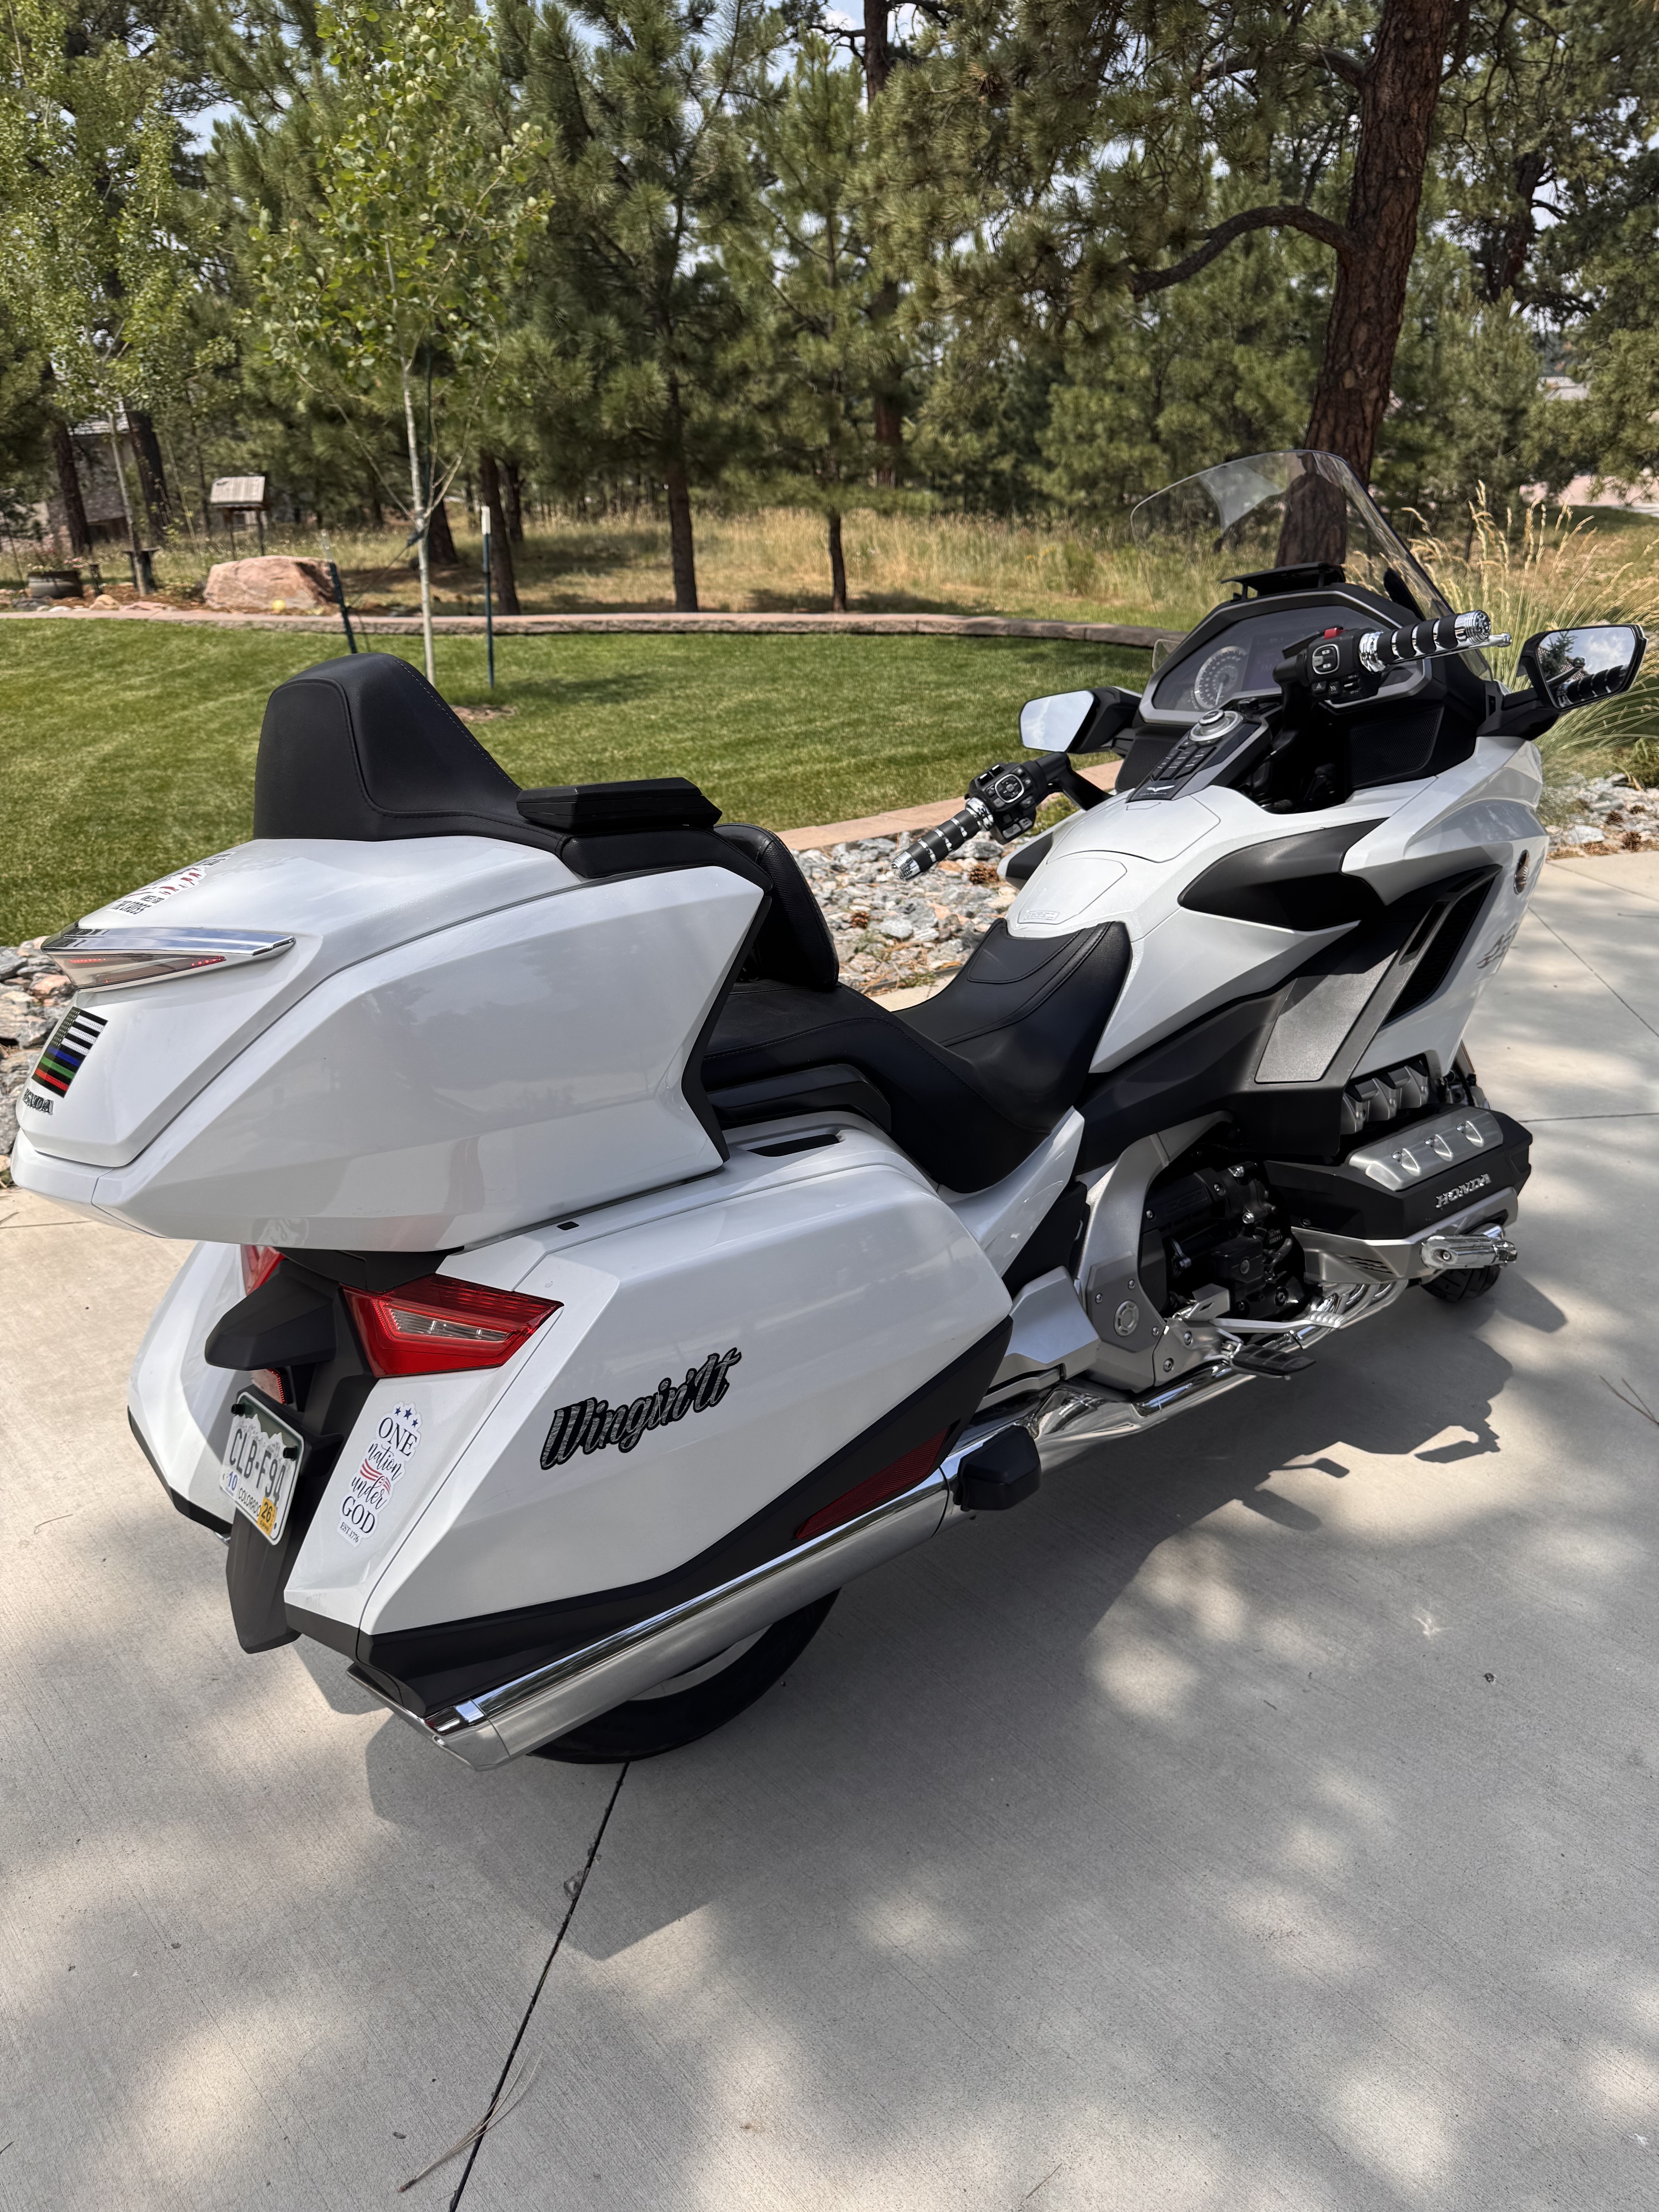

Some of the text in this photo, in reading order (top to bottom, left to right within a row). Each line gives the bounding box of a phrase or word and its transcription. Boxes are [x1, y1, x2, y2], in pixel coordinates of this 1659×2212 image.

[119, 902, 152, 915] CROSS
[1436, 1174, 1491, 1208] HONDA
[379, 1417, 417, 1456] ONE
[368, 1443, 402, 1481] nation
[228, 1472, 237, 1491] 10
[352, 1476, 387, 1510] under
[239, 1487, 261, 1516] COLORADO
[261, 1502, 272, 1523] 26
[342, 1496, 375, 1534] GOD
